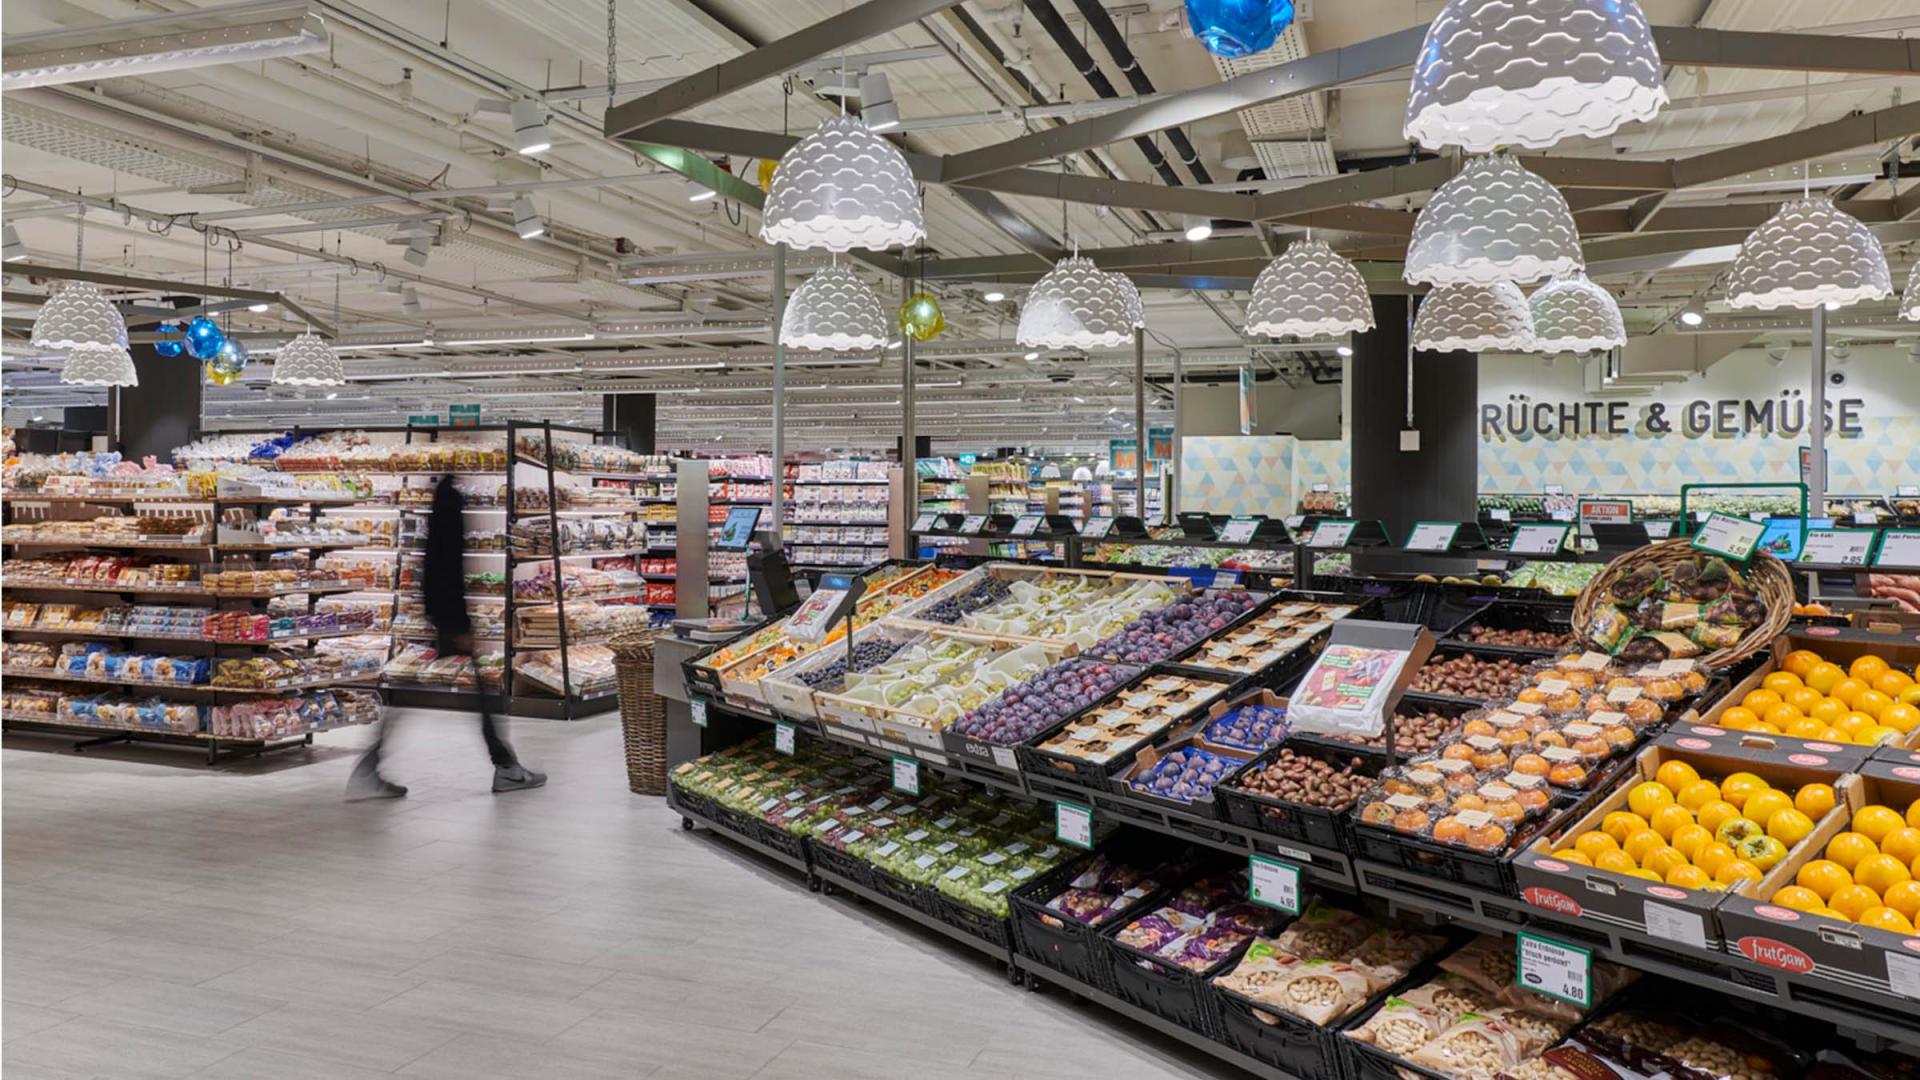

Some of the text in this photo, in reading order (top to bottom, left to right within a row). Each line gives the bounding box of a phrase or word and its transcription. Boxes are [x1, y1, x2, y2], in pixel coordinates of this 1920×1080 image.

[1480, 393, 1630, 435] RÜCHTE
[1646, 402, 1672, 433] &
[1591, 504, 1619, 515] AKTION
[1534, 887, 1577, 913] frutGam
[1752, 939, 1807, 969] frutGam
[1562, 983, 1584, 1000] 4.80
